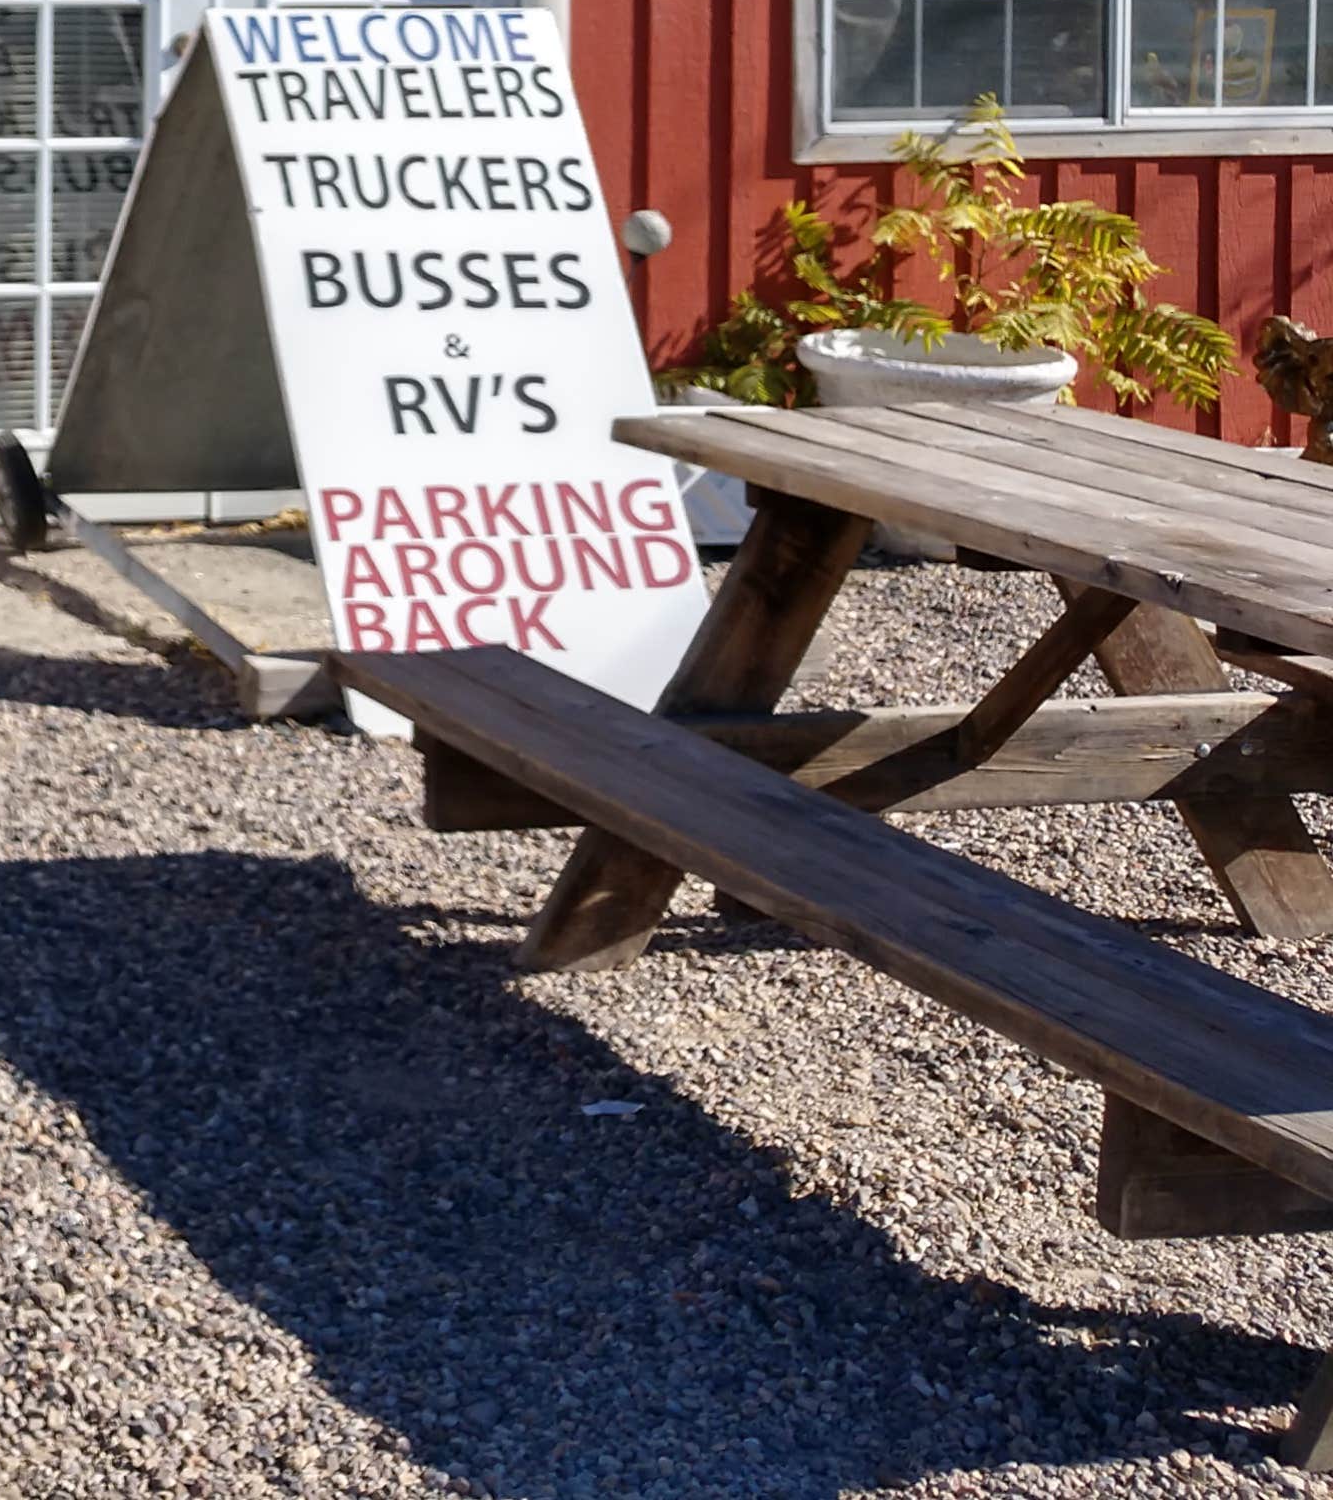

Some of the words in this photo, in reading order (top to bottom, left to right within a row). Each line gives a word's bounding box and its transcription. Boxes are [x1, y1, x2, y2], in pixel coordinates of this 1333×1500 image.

[223, 11, 537, 64] WELCOME
[237, 63, 564, 123] TRAVELERS
[263, 152, 594, 213] TRUCKERS
[301, 250, 593, 312] BUSSES
[444, 333, 471, 359] &
[384, 374, 559, 437] RV'S
[319, 478, 677, 541] PARKING
[342, 534, 693, 599] AROUND
[345, 595, 568, 653] BACK
